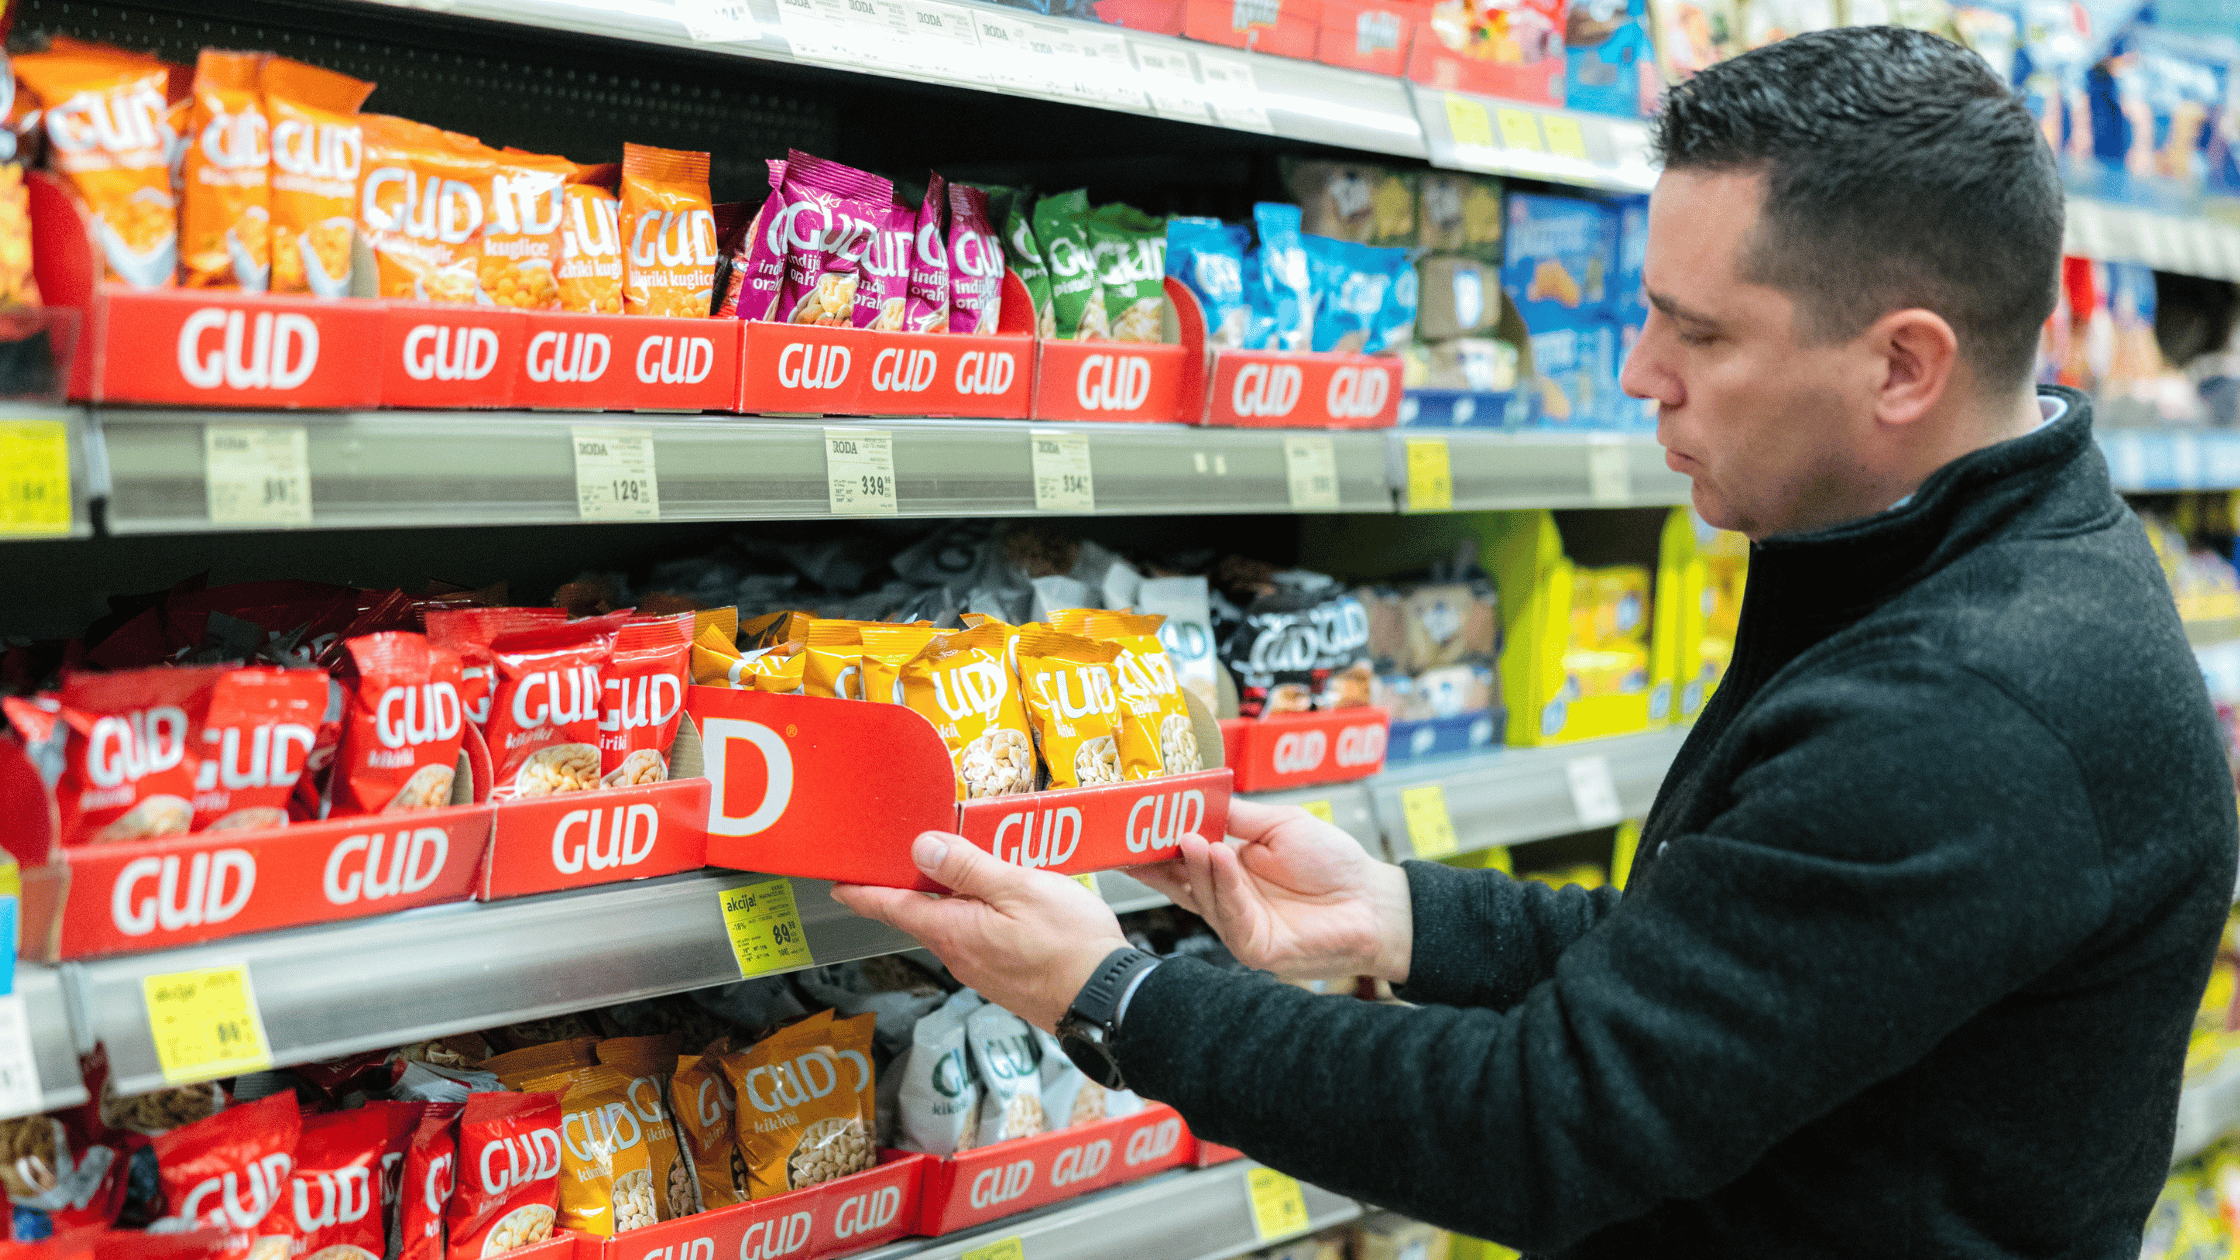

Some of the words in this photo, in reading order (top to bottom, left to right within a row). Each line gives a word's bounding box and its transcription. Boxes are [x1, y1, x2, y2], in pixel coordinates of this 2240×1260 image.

[917, 12, 943, 27] RODA
[983, 24, 1008, 41] RODA
[362, 168, 483, 244] GUD
[787, 201, 878, 262] GUD
[632, 209, 718, 268] GUD
[911, 286, 945, 302] orah
[177, 307, 320, 390] GUD
[403, 325, 499, 381] GUD
[526, 331, 611, 382] GUD
[636, 336, 714, 384] GUD
[778, 343, 851, 389] GUD
[871, 348, 937, 392] GUD
[955, 351, 1015, 395] GUD
[1077, 355, 1151, 410] GUD
[1232, 363, 1302, 417] GUD
[832, 440, 859, 455] RODA
[612, 479, 639, 501] 129
[861, 475, 884, 496] 339
[376, 681, 461, 749] GUD
[88, 706, 188, 787] GUD
[552, 803, 659, 874] GUD
[993, 806, 1082, 869] GUD
[1126, 789, 1205, 853] GUD
[111, 849, 256, 936] GUD
[323, 827, 449, 905] GUD
[726, 893, 757, 912] akcija!
[772, 923, 791, 945] 89
[745, 1052, 836, 1113] GUD
[562, 1102, 641, 1162] GUD
[1125, 1117, 1181, 1166] GUD
[480, 1127, 562, 1196] GUD
[970, 1160, 1035, 1209] GUD
[1051, 1139, 1112, 1187] GUD
[293, 1166, 370, 1232] UD
[834, 1186, 900, 1238] GUD
[740, 1211, 812, 1260] GUD
